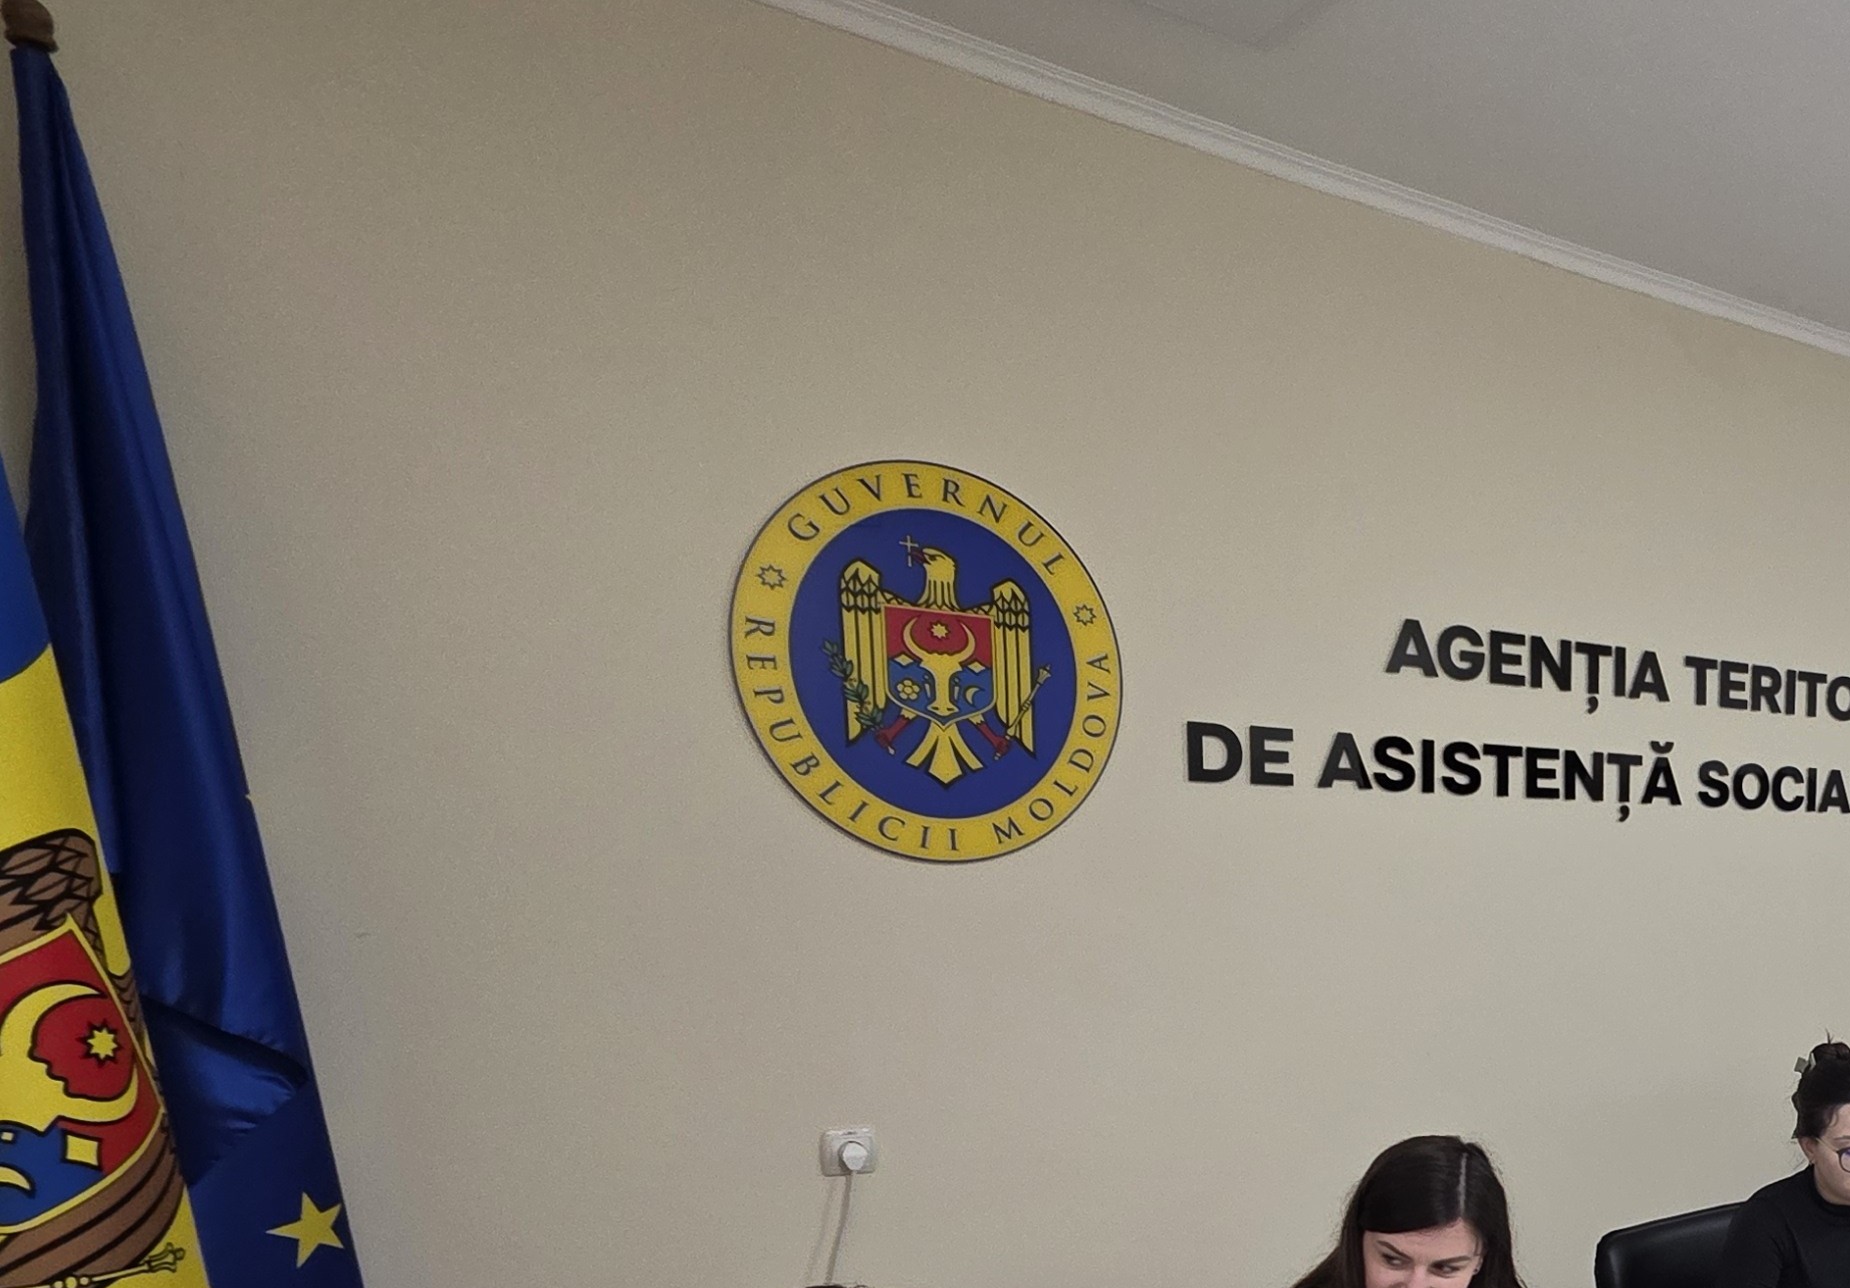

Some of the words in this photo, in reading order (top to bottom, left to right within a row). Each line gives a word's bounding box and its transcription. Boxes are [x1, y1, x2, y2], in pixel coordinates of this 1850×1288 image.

[786, 472, 1067, 576] GUVERNUL
[1385, 618, 1670, 715] AGENȚIA
[744, 615, 960, 851] REPUBLICII
[992, 652, 1111, 845] MOLDOVA
[1186, 720, 1294, 787] DE
[1317, 732, 1682, 823] ASISTENȚĂ
